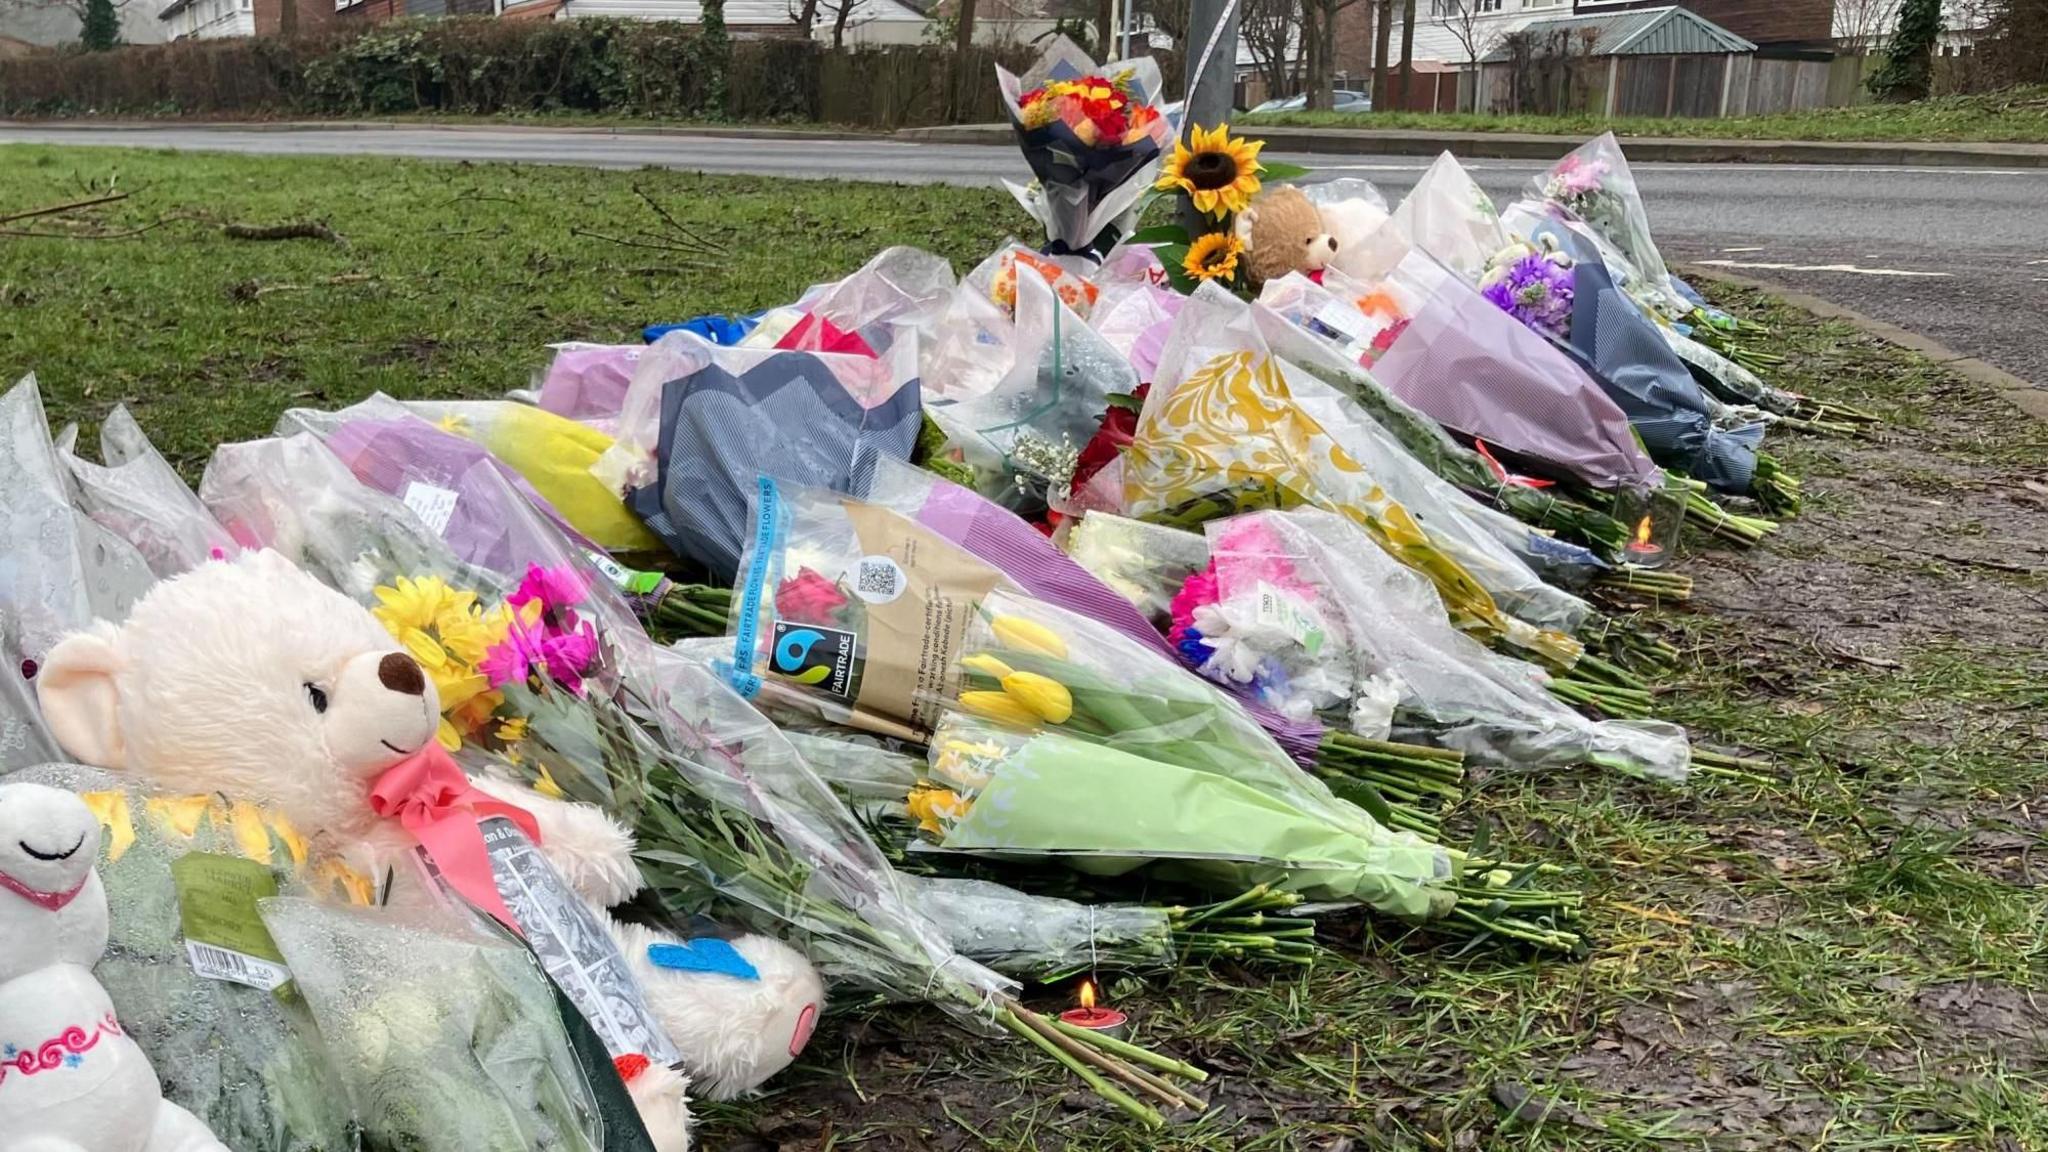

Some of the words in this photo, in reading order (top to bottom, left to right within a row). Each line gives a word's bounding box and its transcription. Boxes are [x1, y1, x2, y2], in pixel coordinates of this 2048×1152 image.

[760, 483, 772, 531] FLOWERS
[832, 634, 851, 693] FAIRTRADE
[496, 827, 506, 840] &
